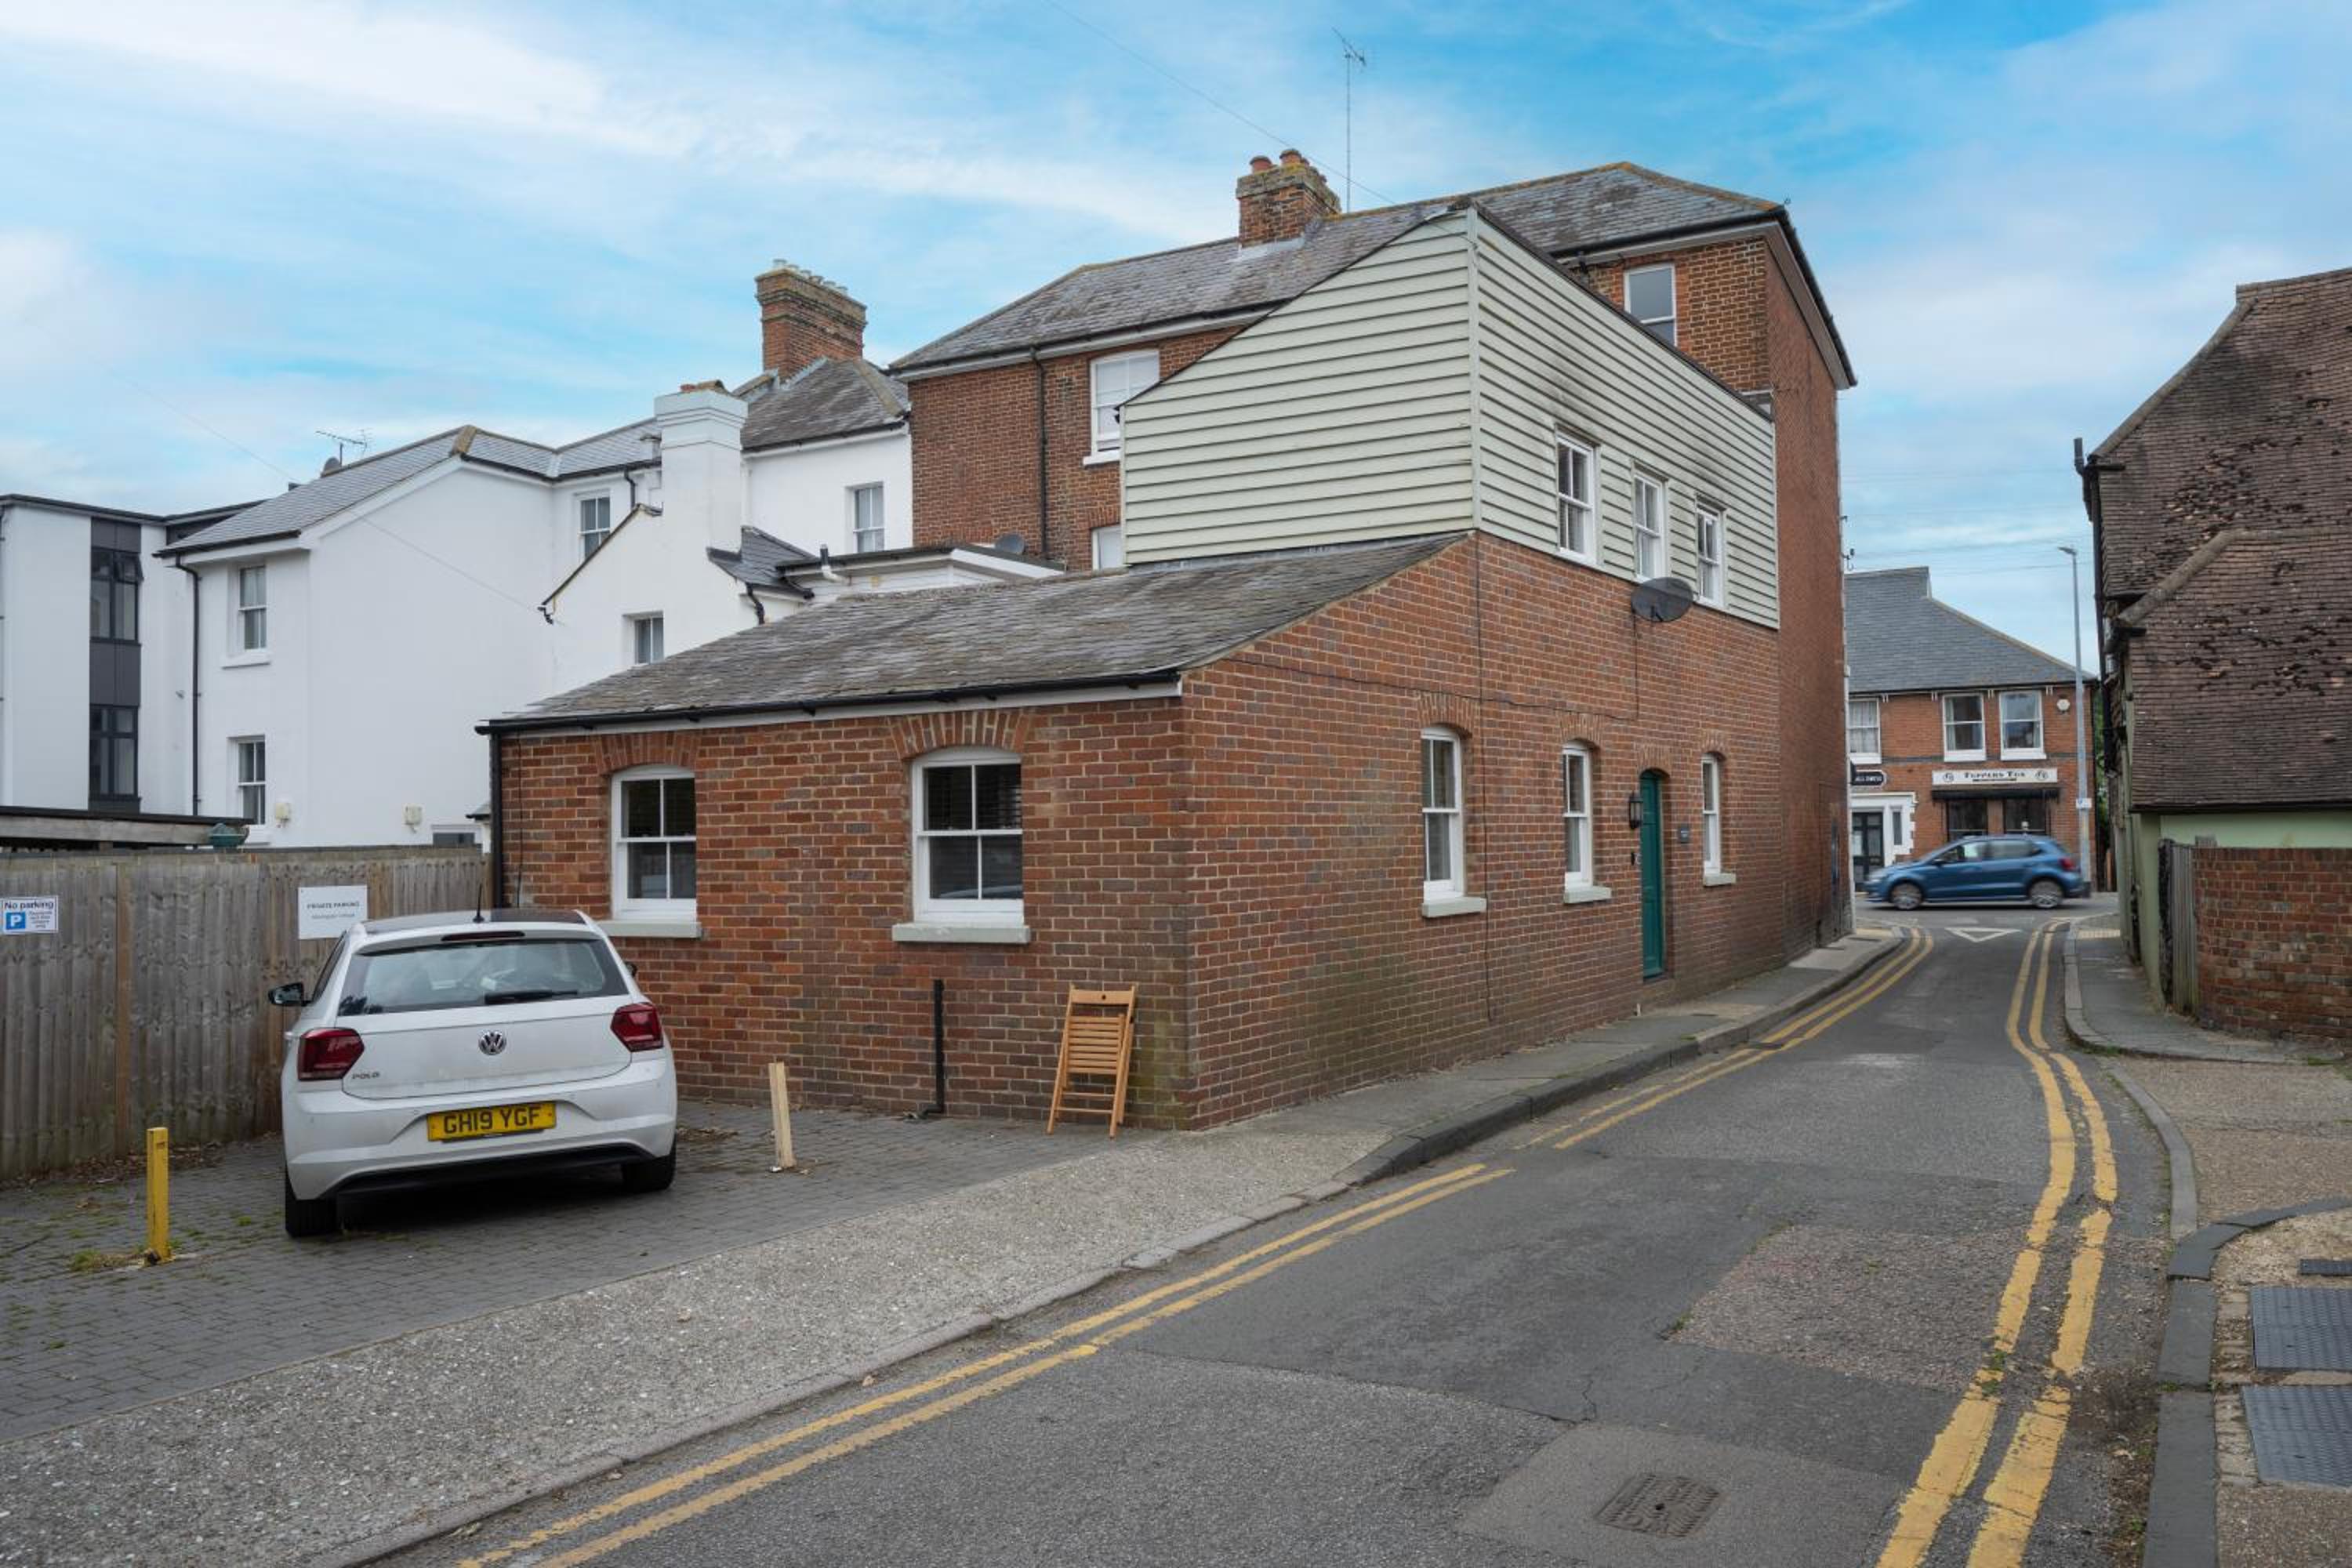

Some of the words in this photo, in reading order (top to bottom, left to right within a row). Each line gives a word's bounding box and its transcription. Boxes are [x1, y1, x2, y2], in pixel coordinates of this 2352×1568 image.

[20, 901, 54, 909] parking
[351, 1071, 380, 1080] POLO
[444, 1111, 493, 1134] GH19
[499, 1105, 542, 1129] YGF
